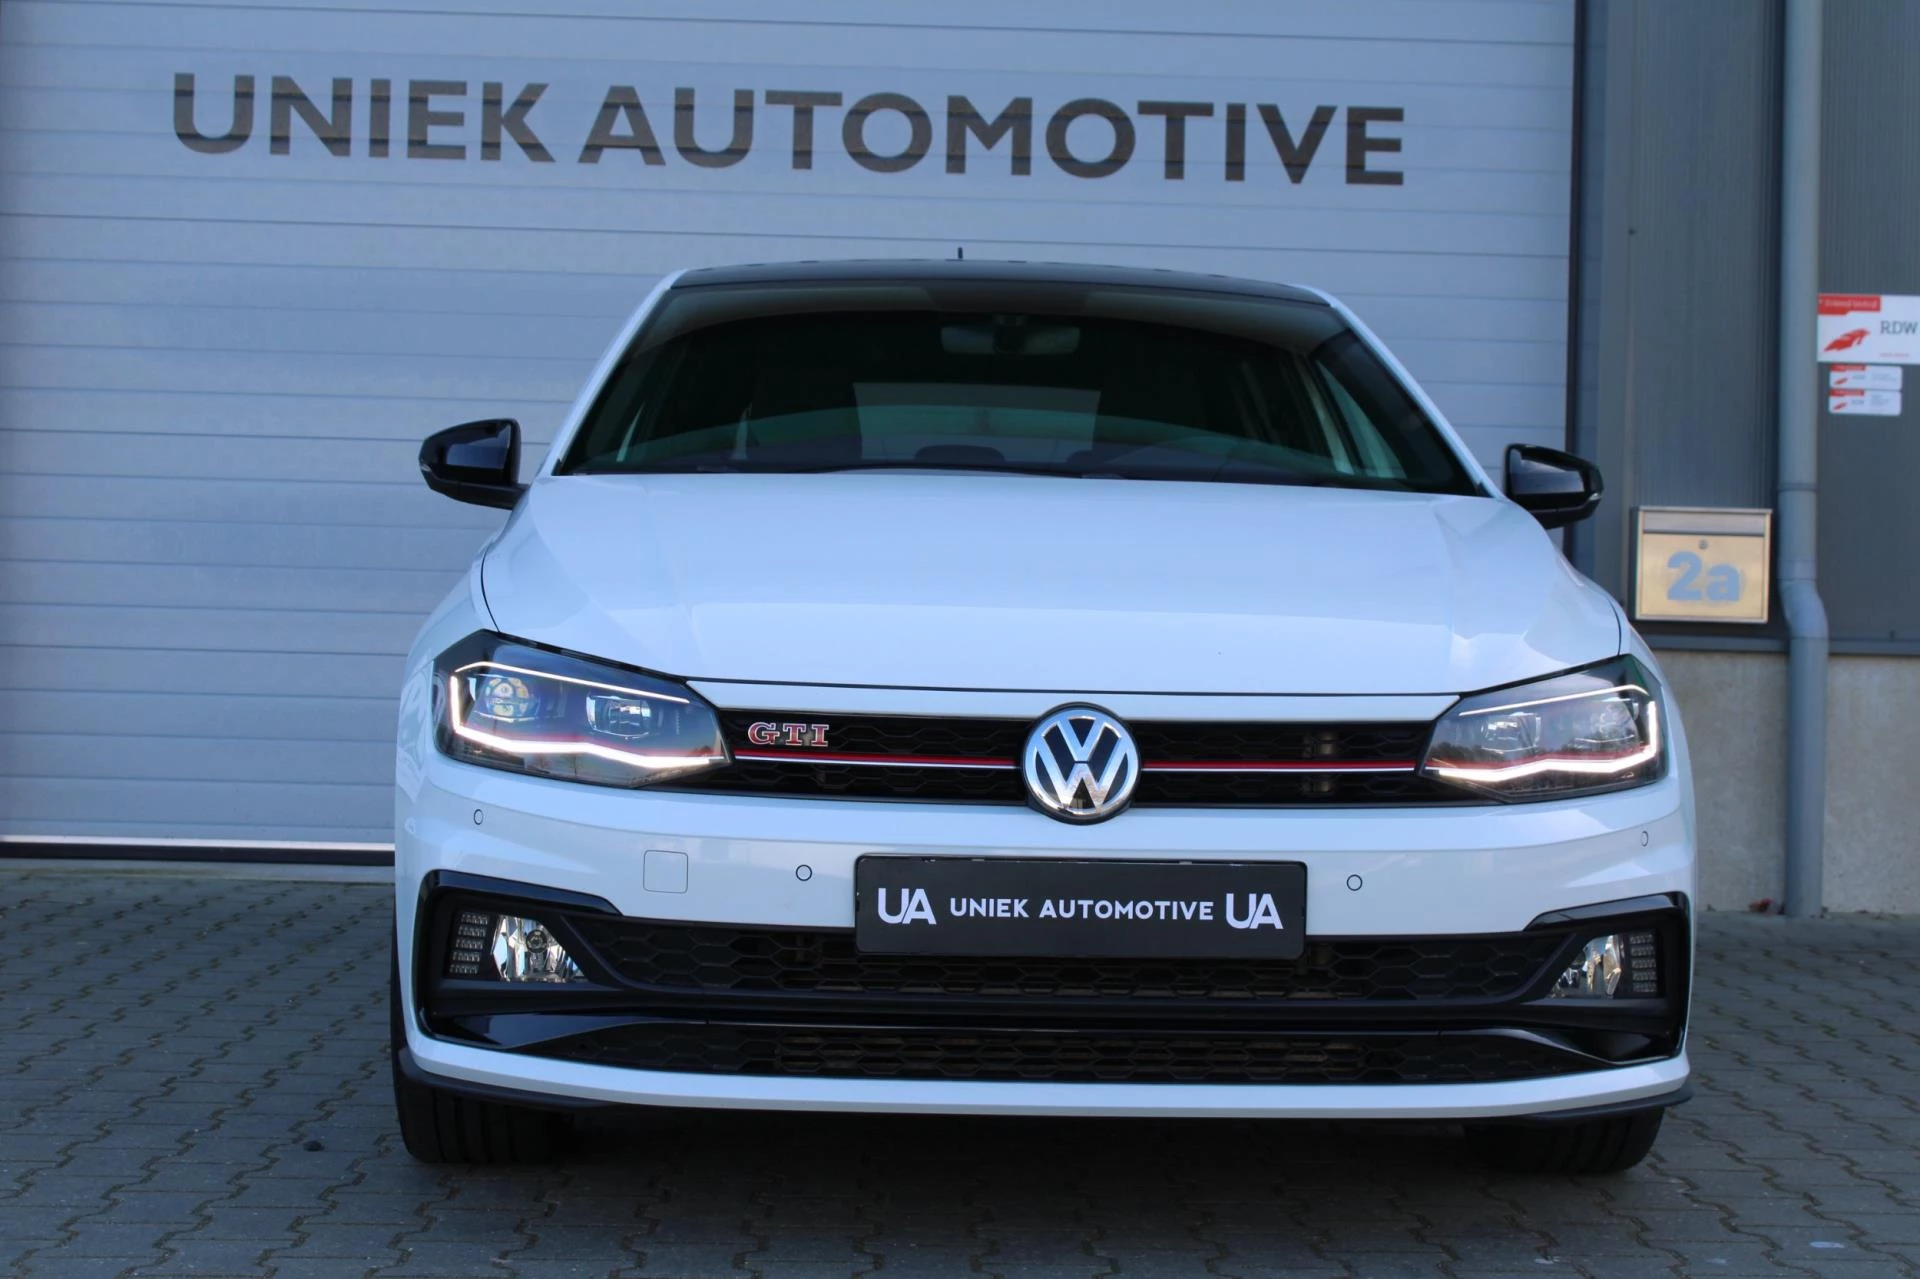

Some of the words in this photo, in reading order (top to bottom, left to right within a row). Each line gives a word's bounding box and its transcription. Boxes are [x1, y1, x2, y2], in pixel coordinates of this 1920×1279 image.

[173, 72, 555, 164] UNIEK
[577, 85, 1405, 186] AUTOMOTIVE
[1880, 320, 1918, 334] RDW
[1667, 551, 1740, 601] 2a
[747, 722, 830, 747] GTI
[949, 897, 1030, 919] UNIEK
[1038, 900, 1215, 921] AUTOMOTIVE
